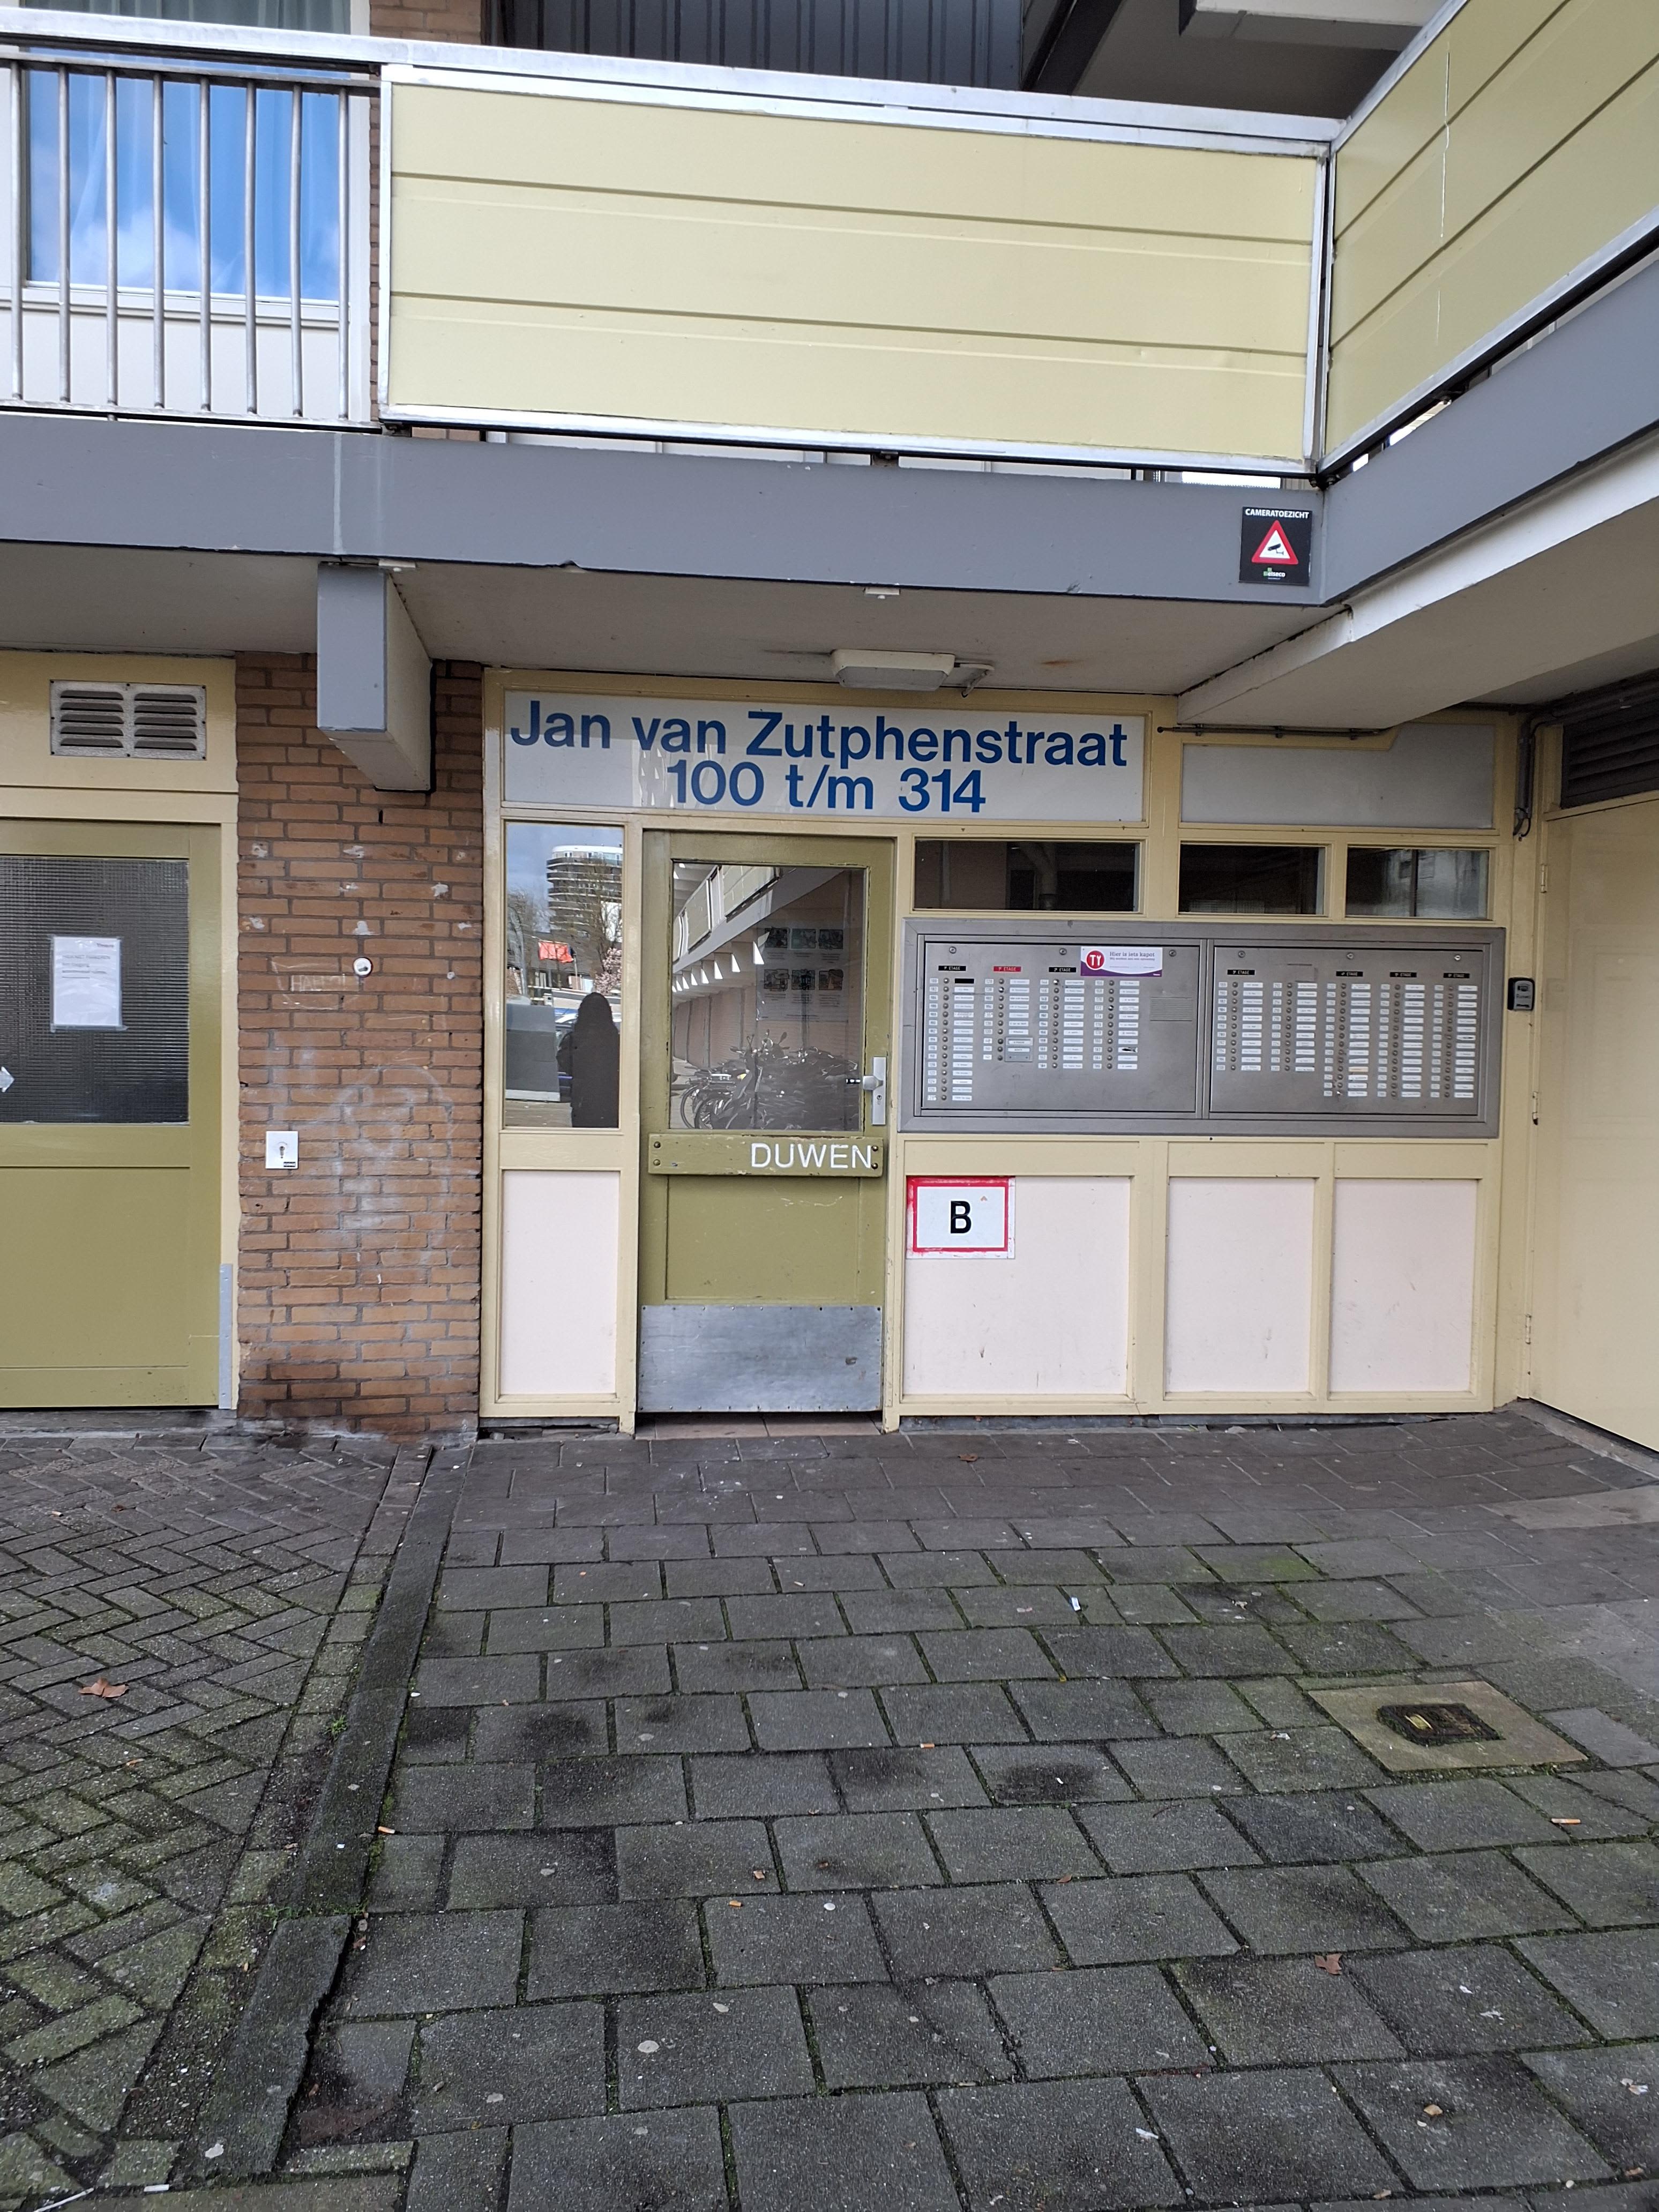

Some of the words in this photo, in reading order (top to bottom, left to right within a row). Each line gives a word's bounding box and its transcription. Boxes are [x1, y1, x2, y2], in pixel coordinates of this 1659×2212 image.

[1245, 509, 1309, 519] CAMERATOEZICHT
[511, 700, 610, 749] Jan
[632, 717, 726, 754] van
[746, 711, 1127, 769] Zutphenstraat
[667, 759, 764, 806] 100
[785, 765, 873, 810] t/m
[899, 767, 986, 813] 314
[751, 1142, 871, 1169] DUWEN
[950, 1200, 972, 1234] B
